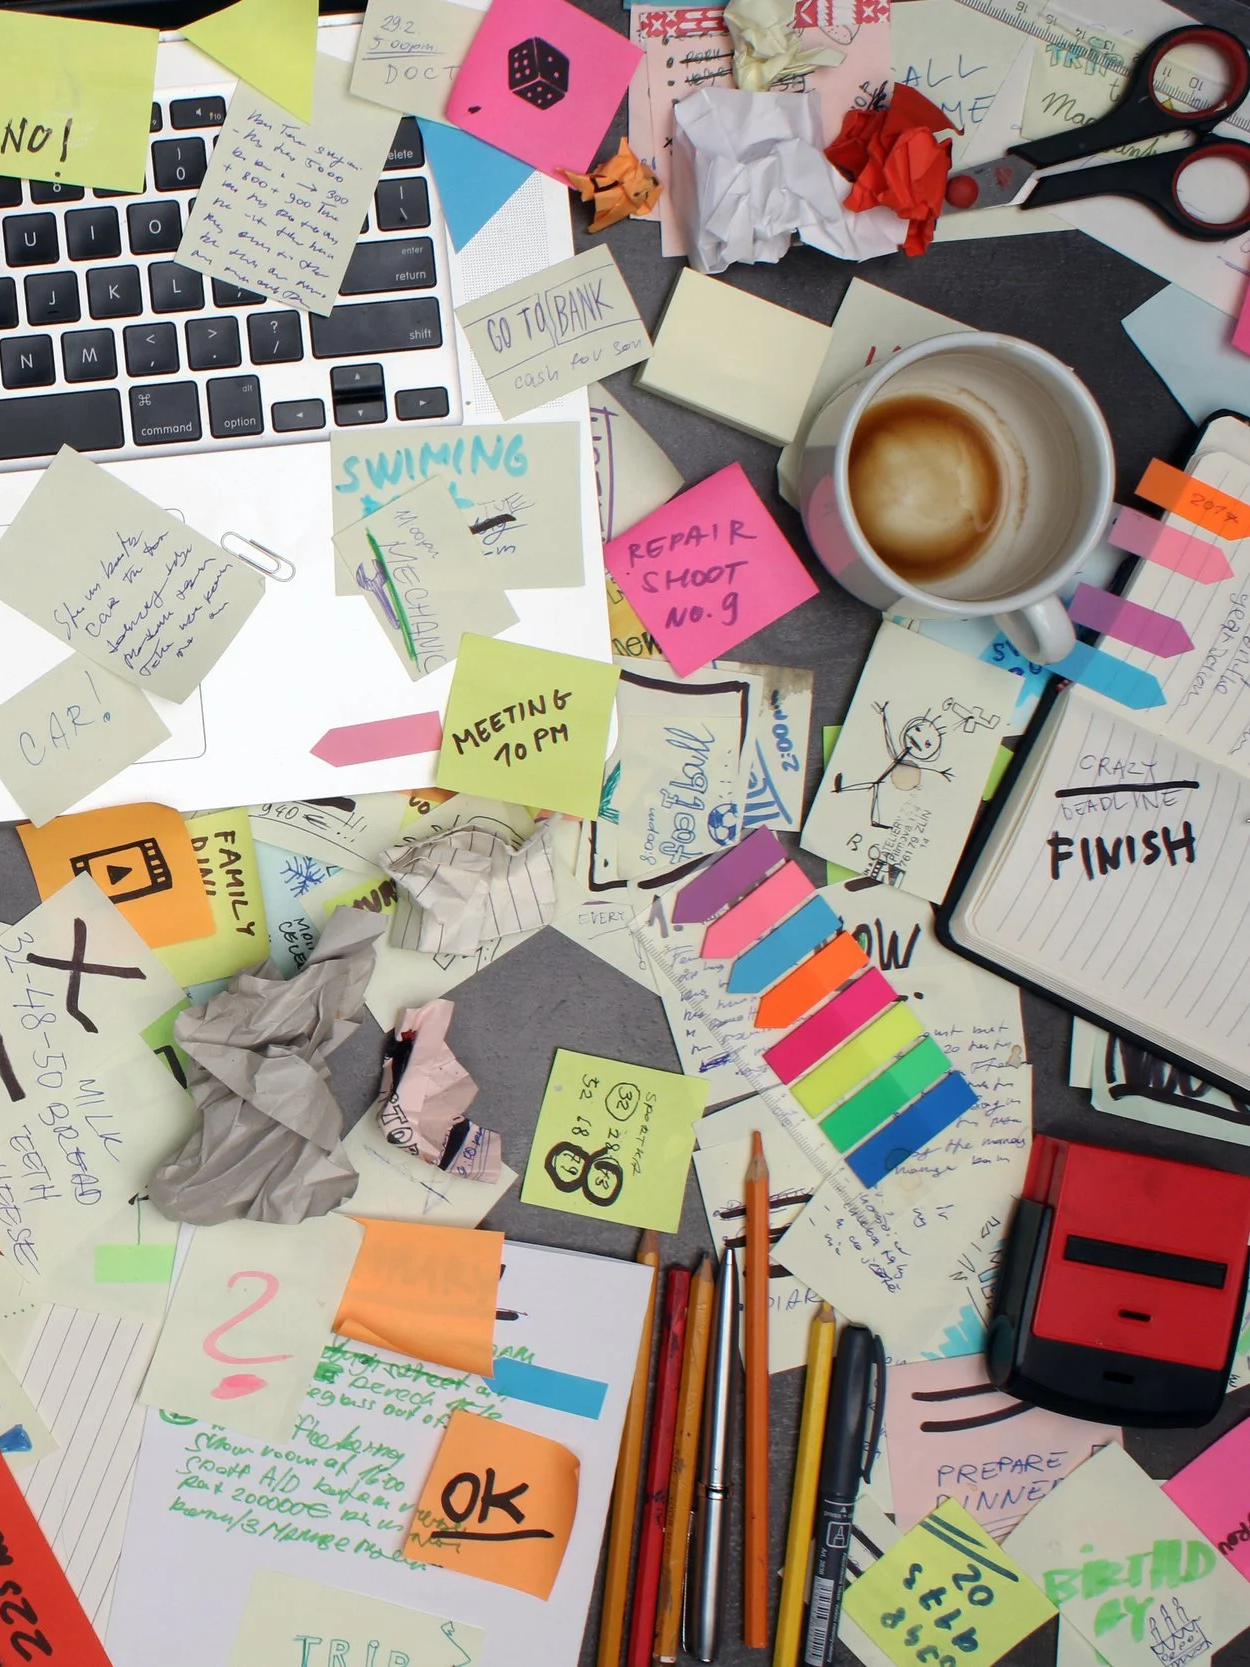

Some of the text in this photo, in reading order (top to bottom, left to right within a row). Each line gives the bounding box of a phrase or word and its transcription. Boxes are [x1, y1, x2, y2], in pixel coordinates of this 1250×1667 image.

[902, 53, 989, 87] ALL
[0, 116, 73, 177] NO!
[387, 150, 414, 161] elete
[176, 166, 186, 180] 0
[24, 231, 37, 247] U
[148, 219, 162, 234] O
[401, 246, 424, 255] enter
[172, 278, 182, 293] L
[395, 270, 427, 282] return
[48, 290, 57, 306] J
[108, 284, 120, 300] K
[486, 316, 512, 354] GO
[553, 278, 614, 338] BANK
[409, 327, 432, 342] shift
[20, 354, 33, 369] N
[81, 347, 97, 363] M
[241, 384, 254, 393] alt
[141, 421, 193, 438] command
[223, 415, 257, 430] option
[335, 433, 529, 494] SWIMING
[628, 519, 758, 569] REPAIR
[641, 560, 749, 594] SHOOT
[380, 540, 448, 675] MECHANIC
[451, 688, 573, 755] MEETING
[493, 723, 570, 767] 10 PM
[1079, 754, 1158, 784] CRAZY
[1061, 788, 1182, 821] DEADLINE
[1046, 820, 1196, 880] FINISH
[214, 829, 255, 936] FAMILY
[73, 1078, 124, 1163] MILK
[39, 1101, 102, 1207] BREAD
[767, 1287, 826, 1310] DIAR
[938, 1450, 1070, 1487] PREPARE
[440, 1466, 530, 1526] OK
